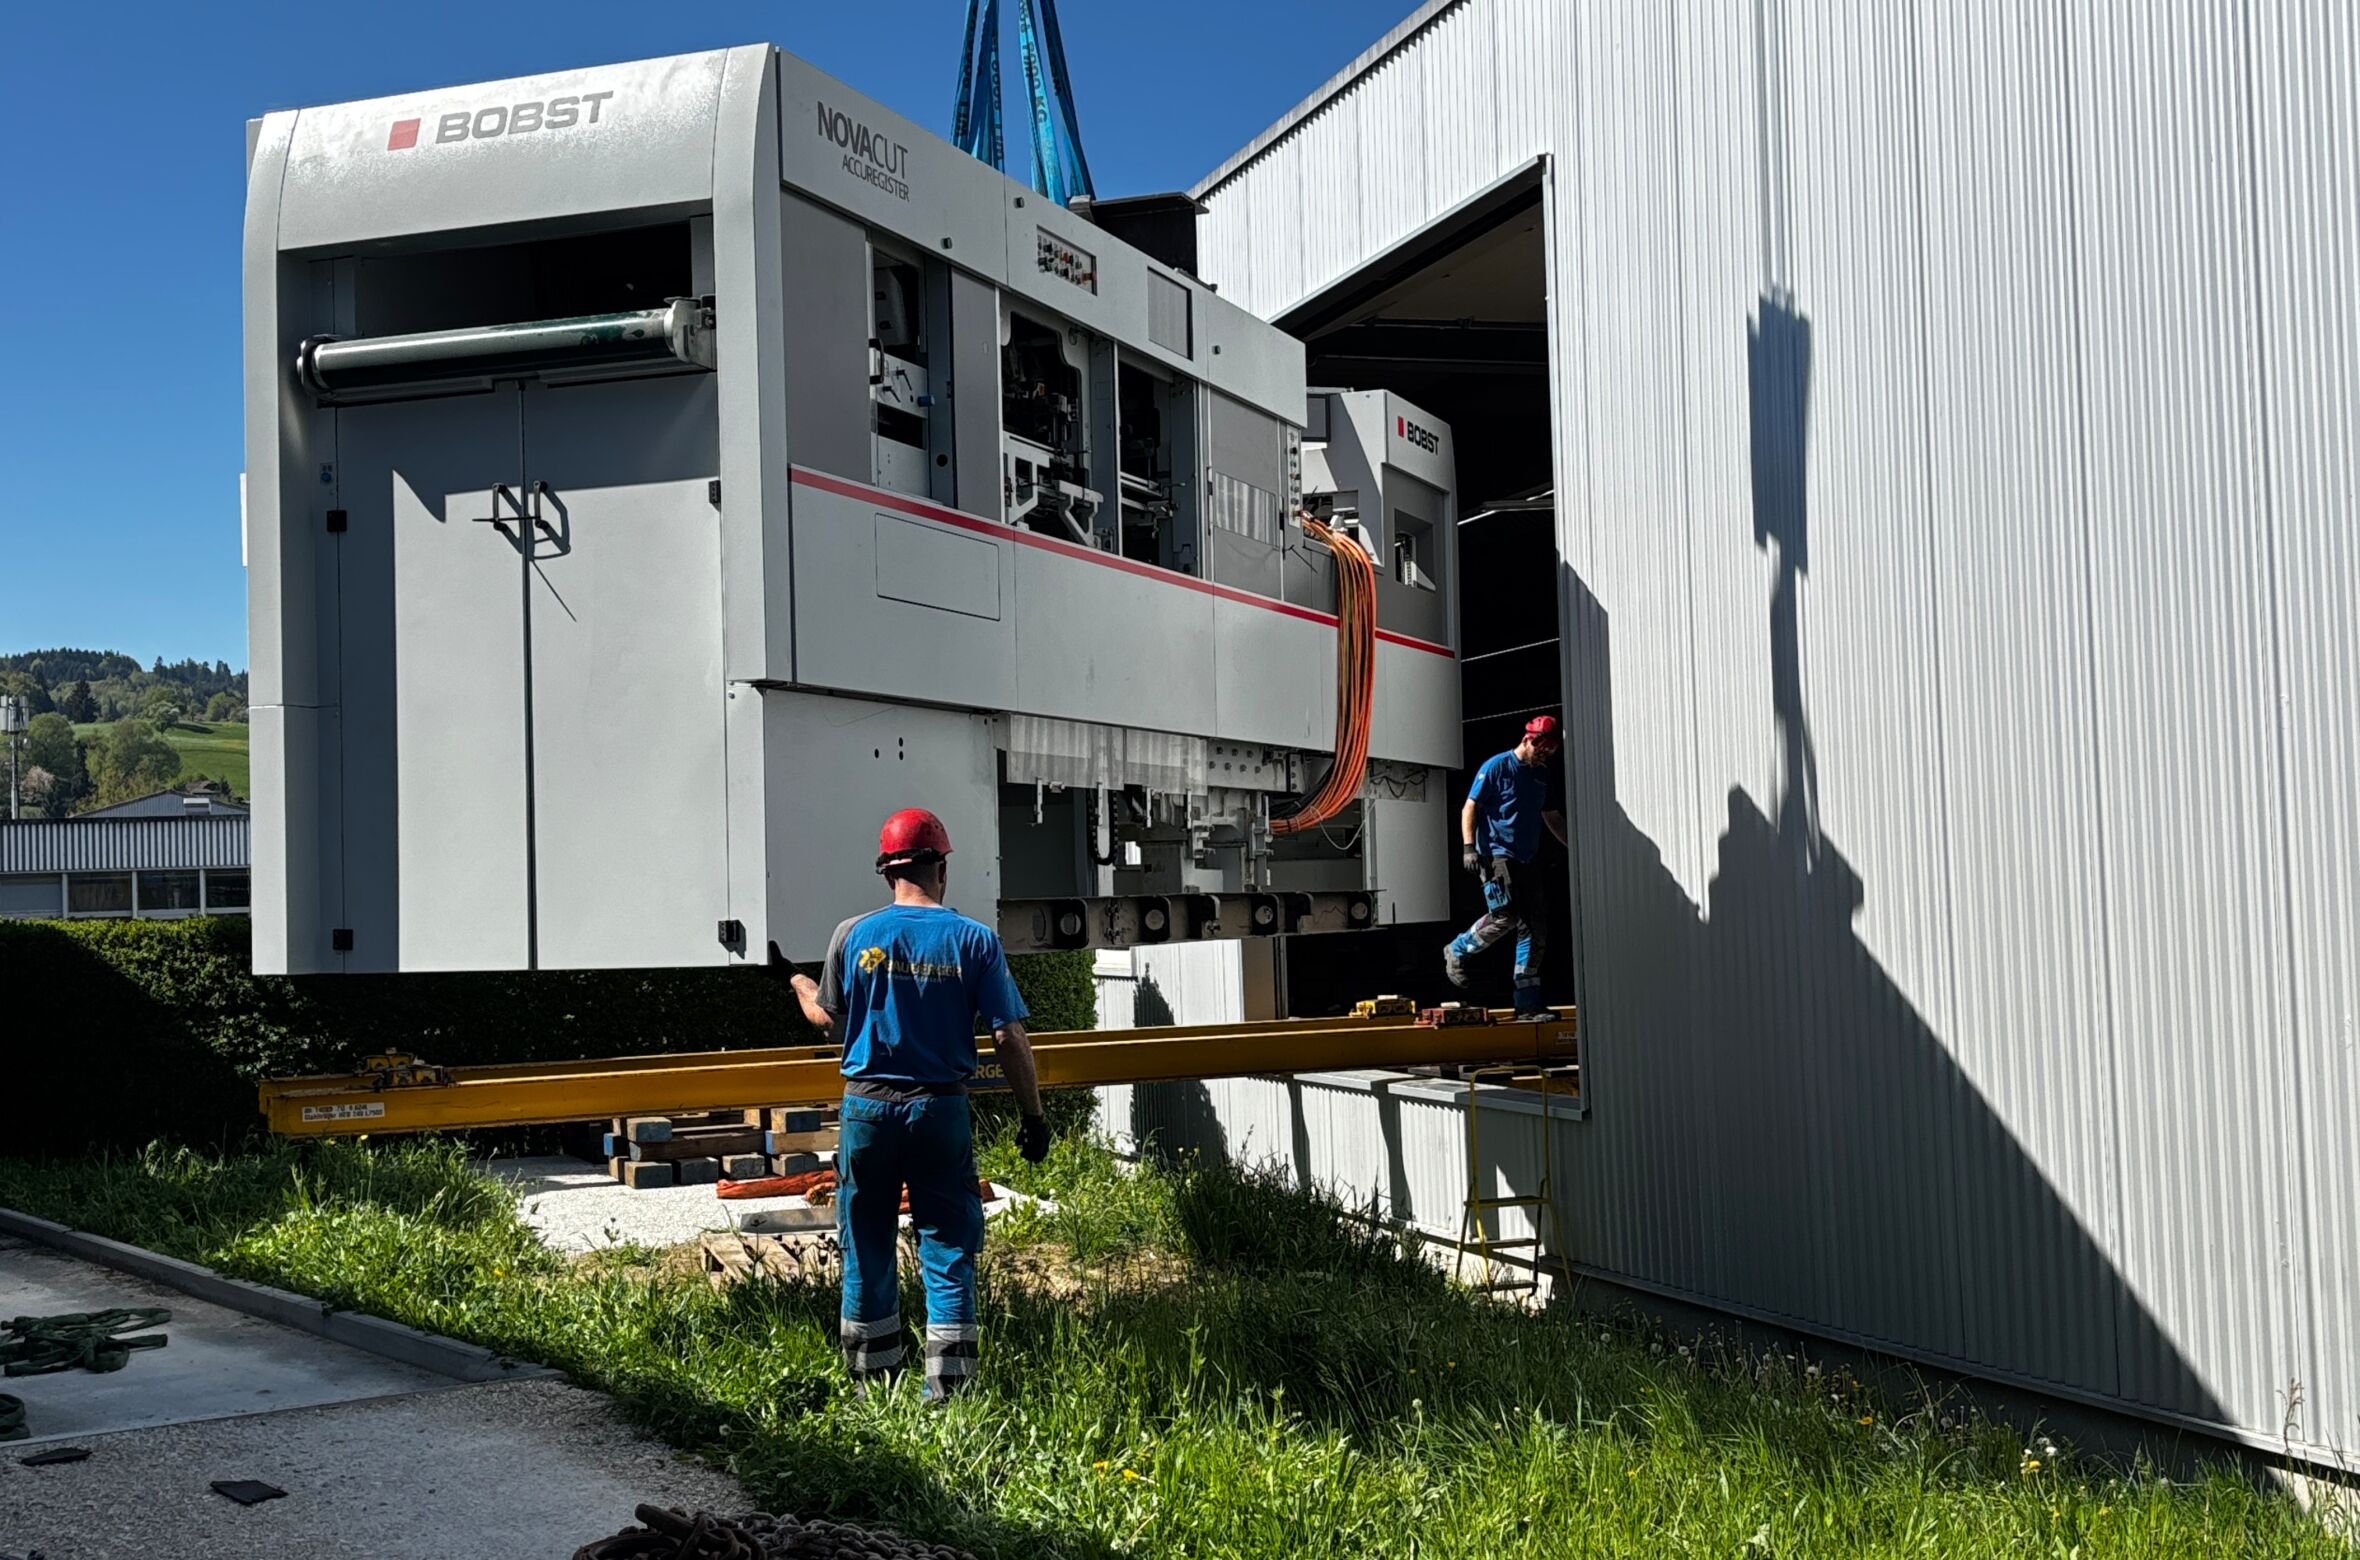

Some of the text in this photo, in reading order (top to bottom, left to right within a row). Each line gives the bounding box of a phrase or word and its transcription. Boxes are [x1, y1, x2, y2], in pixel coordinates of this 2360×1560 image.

[435, 90, 614, 144] BOBST
[817, 100, 908, 179] NOVACUT
[841, 153, 910, 202] ACCUREGISTER
[1407, 420, 1440, 456] BOBST
